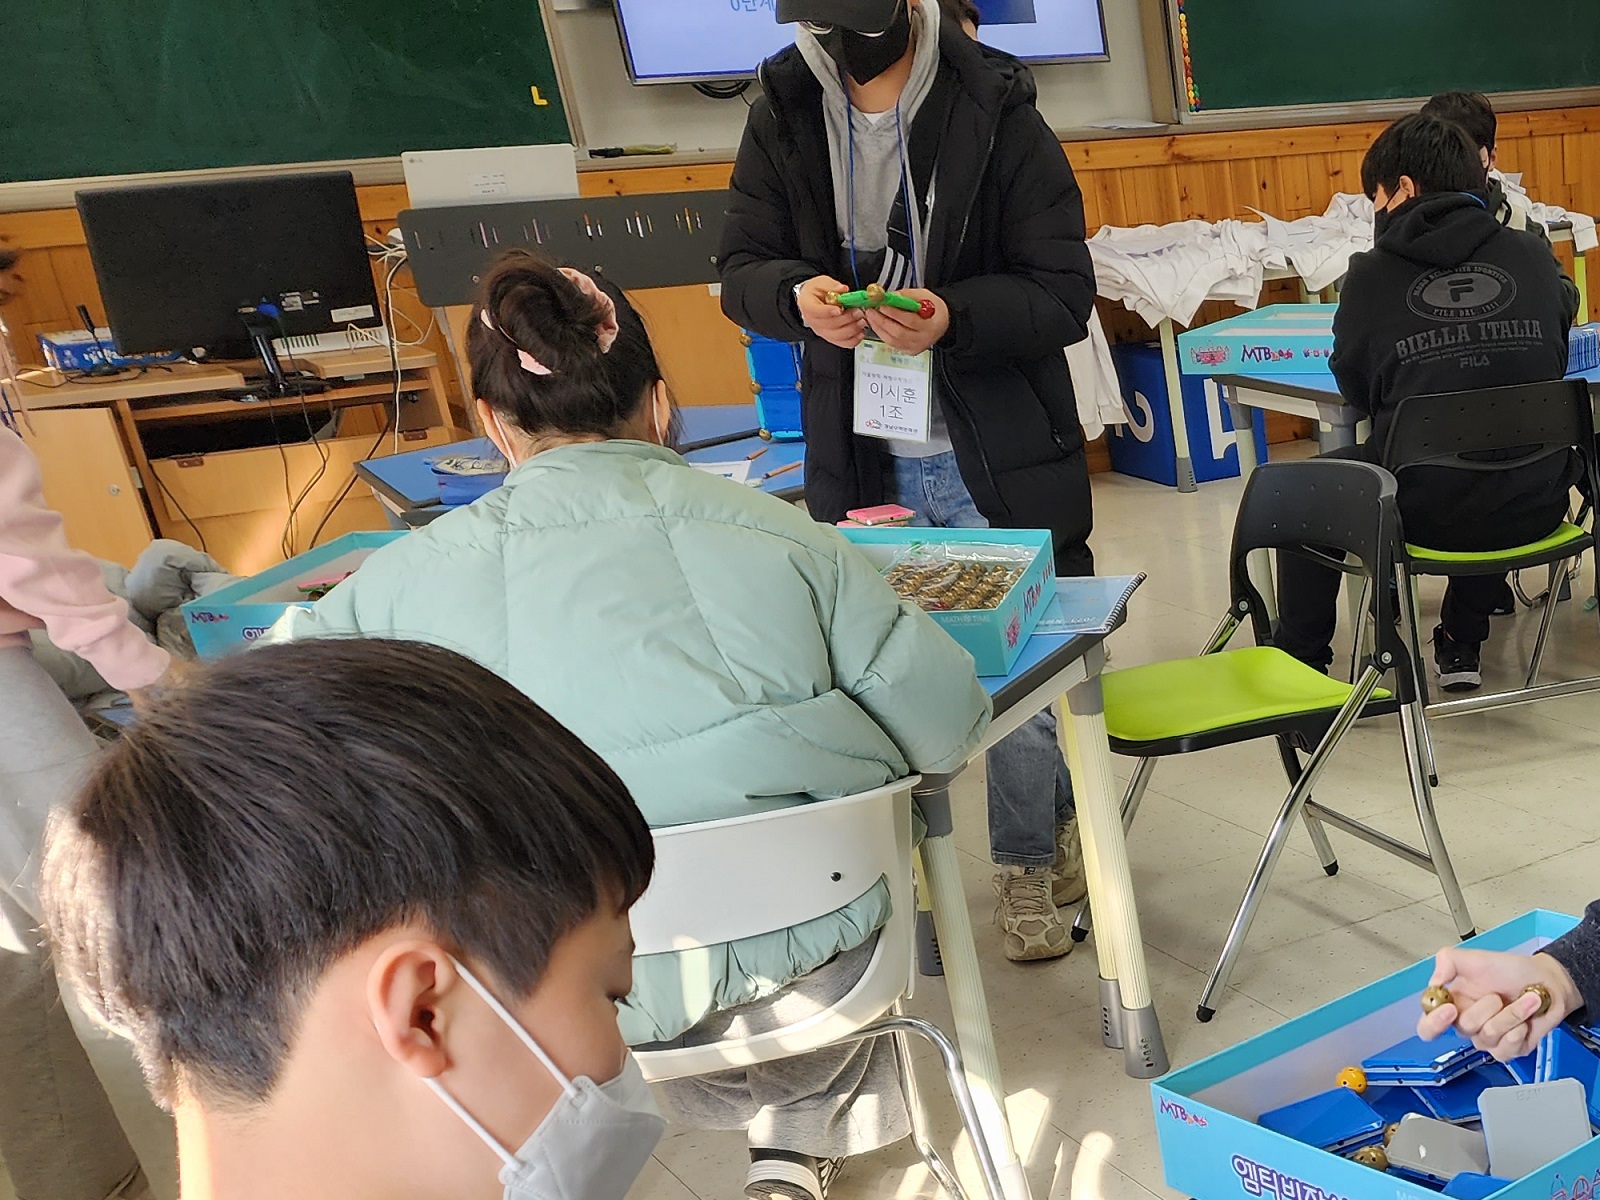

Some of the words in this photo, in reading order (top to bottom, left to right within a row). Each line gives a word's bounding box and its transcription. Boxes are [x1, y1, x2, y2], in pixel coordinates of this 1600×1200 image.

[1395, 323, 1471, 359] BIELLA
[1478, 319, 1543, 341] ITALIA
[1459, 354, 1491, 369] FILA
[870, 382, 917, 405] 이시훈
[880, 404, 903, 420] 1조
